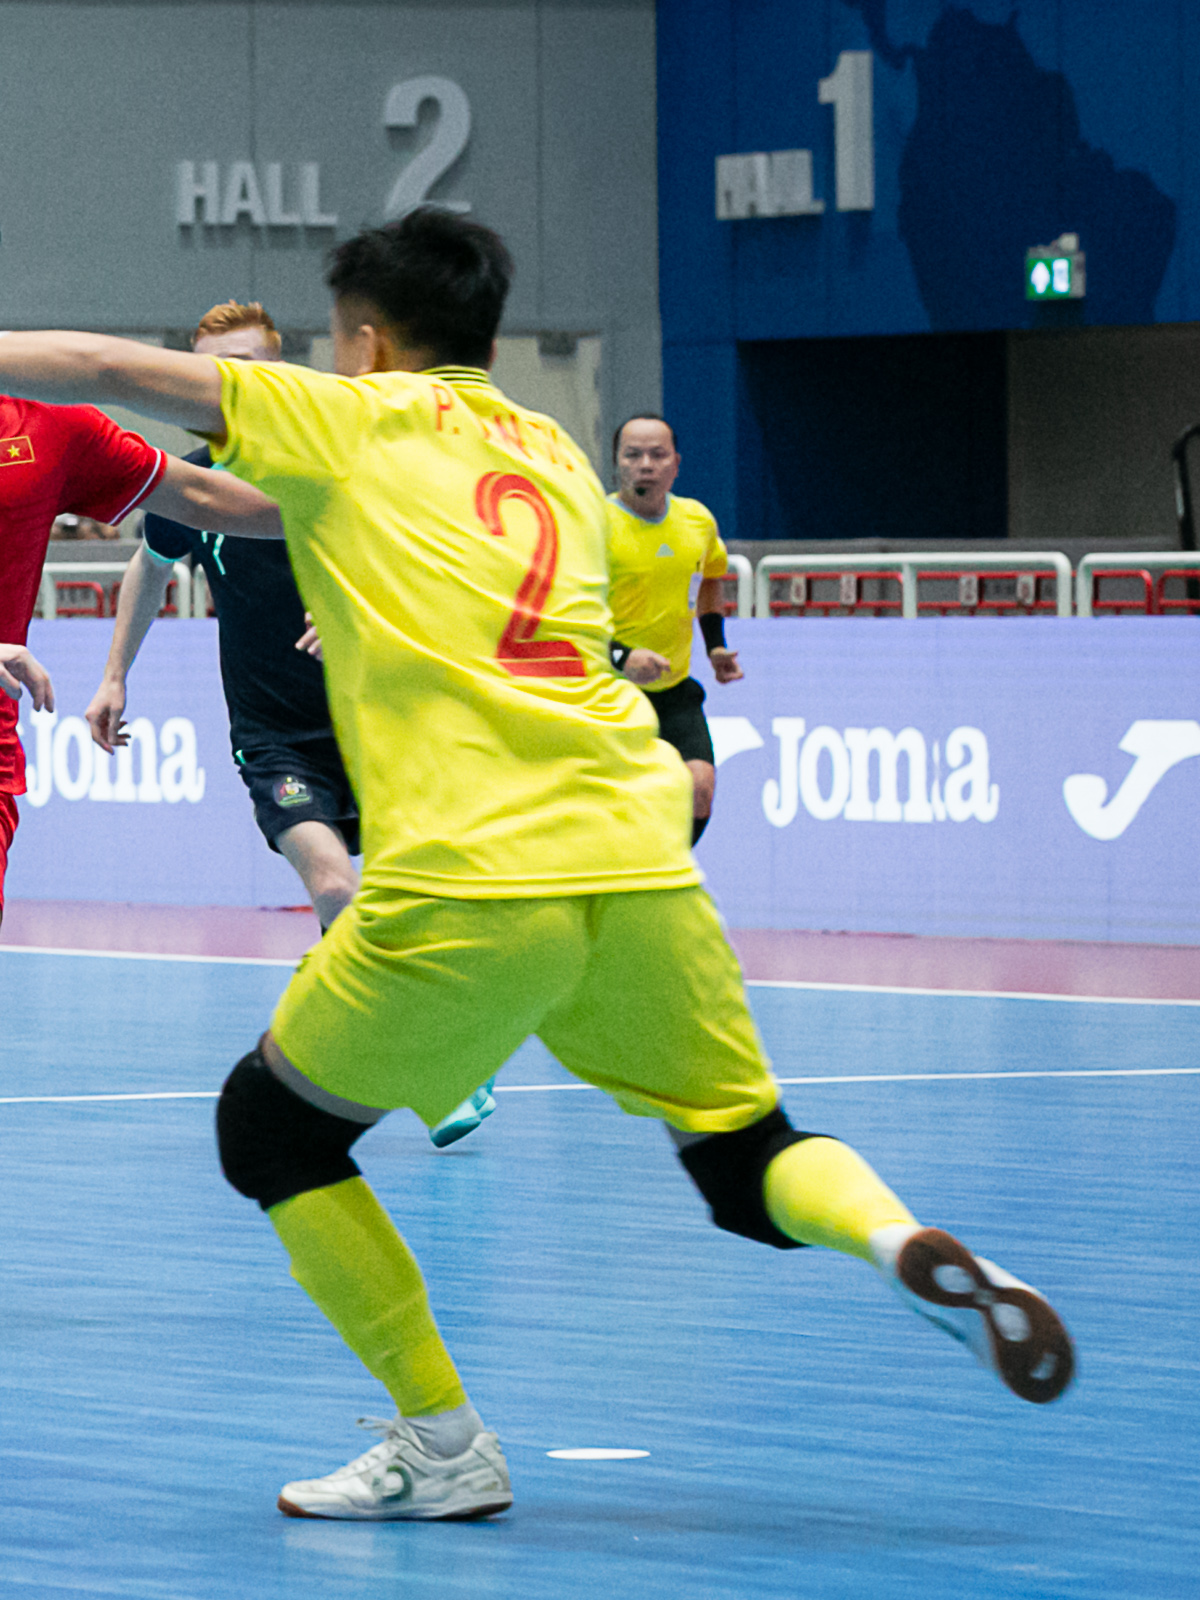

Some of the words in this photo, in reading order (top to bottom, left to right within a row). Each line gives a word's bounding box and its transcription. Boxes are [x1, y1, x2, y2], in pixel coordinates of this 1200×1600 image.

[175, 159, 338, 225] HALL
[383, 75, 472, 222] 2
[818, 49, 875, 212] 1
[474, 471, 587, 678] 2
[762, 717, 1000, 829] Joma
